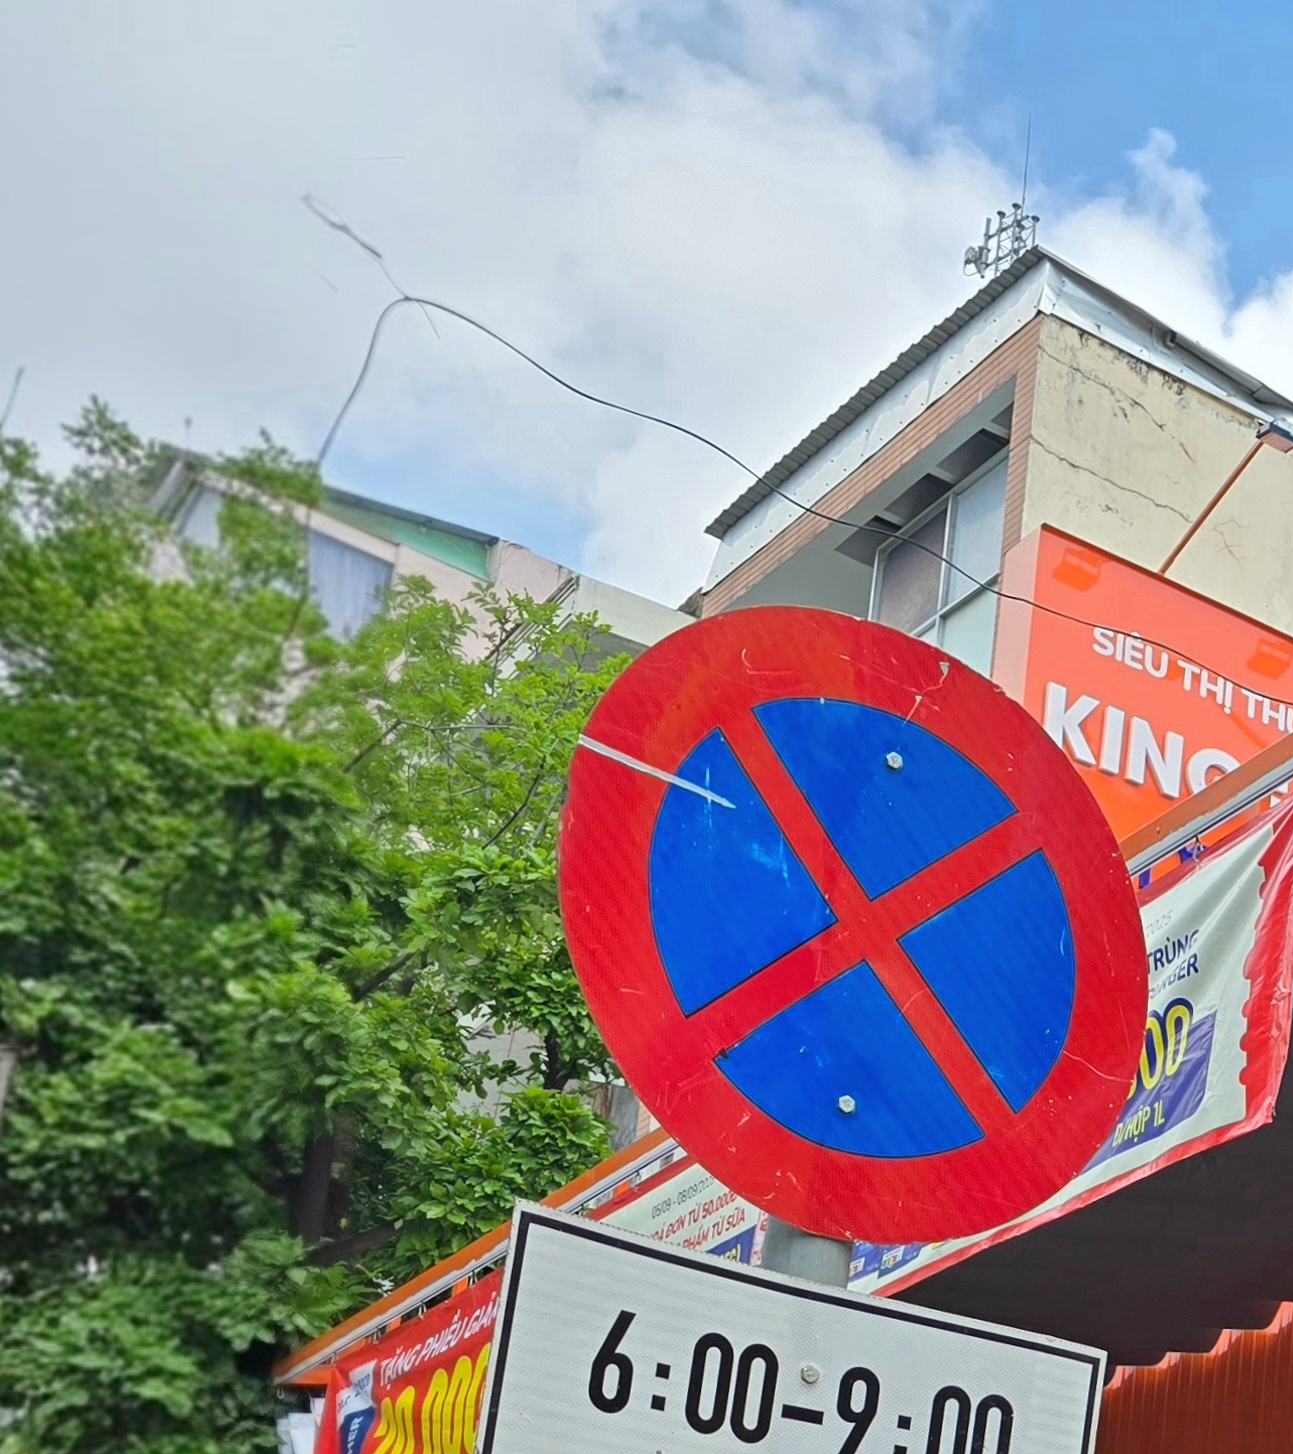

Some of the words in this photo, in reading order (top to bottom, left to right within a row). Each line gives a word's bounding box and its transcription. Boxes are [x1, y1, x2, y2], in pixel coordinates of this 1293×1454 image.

[1092, 625, 1168, 679] SIÊU
[1177, 658, 1234, 714] THỊ
[415, 1308, 464, 1367] PHIẾU
